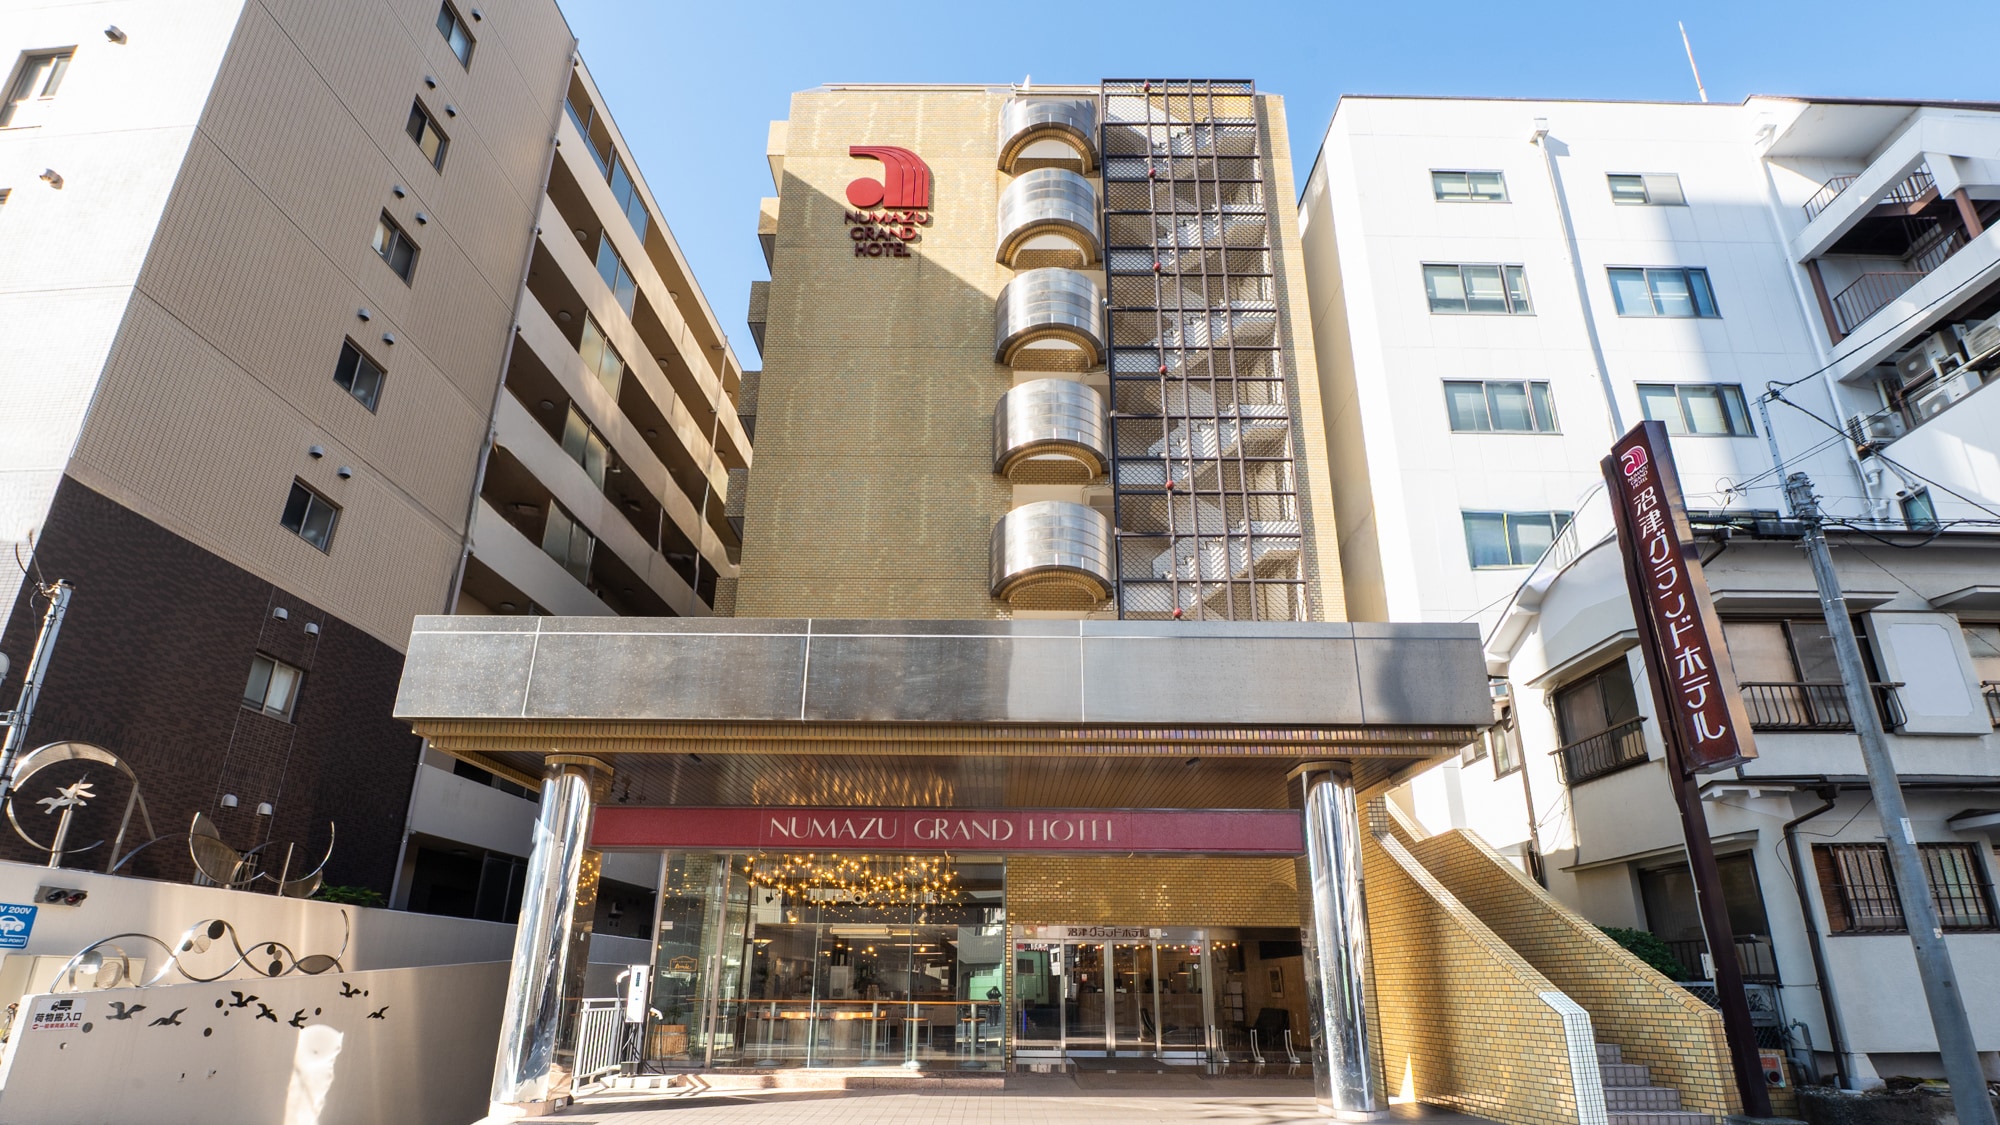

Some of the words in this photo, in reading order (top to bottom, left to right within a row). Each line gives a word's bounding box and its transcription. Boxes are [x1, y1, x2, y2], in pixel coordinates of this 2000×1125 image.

[844, 210, 929, 226] NUMAZU
[850, 226, 917, 241] GRAND
[854, 242, 911, 257] HOTEL
[1633, 485, 1726, 743] 沼津グランドホテル
[770, 816, 898, 839] NUMAZU
[914, 818, 1014, 841] GRAND
[1028, 819, 1120, 841] HOTEL
[8, 906, 33, 915] 200V
